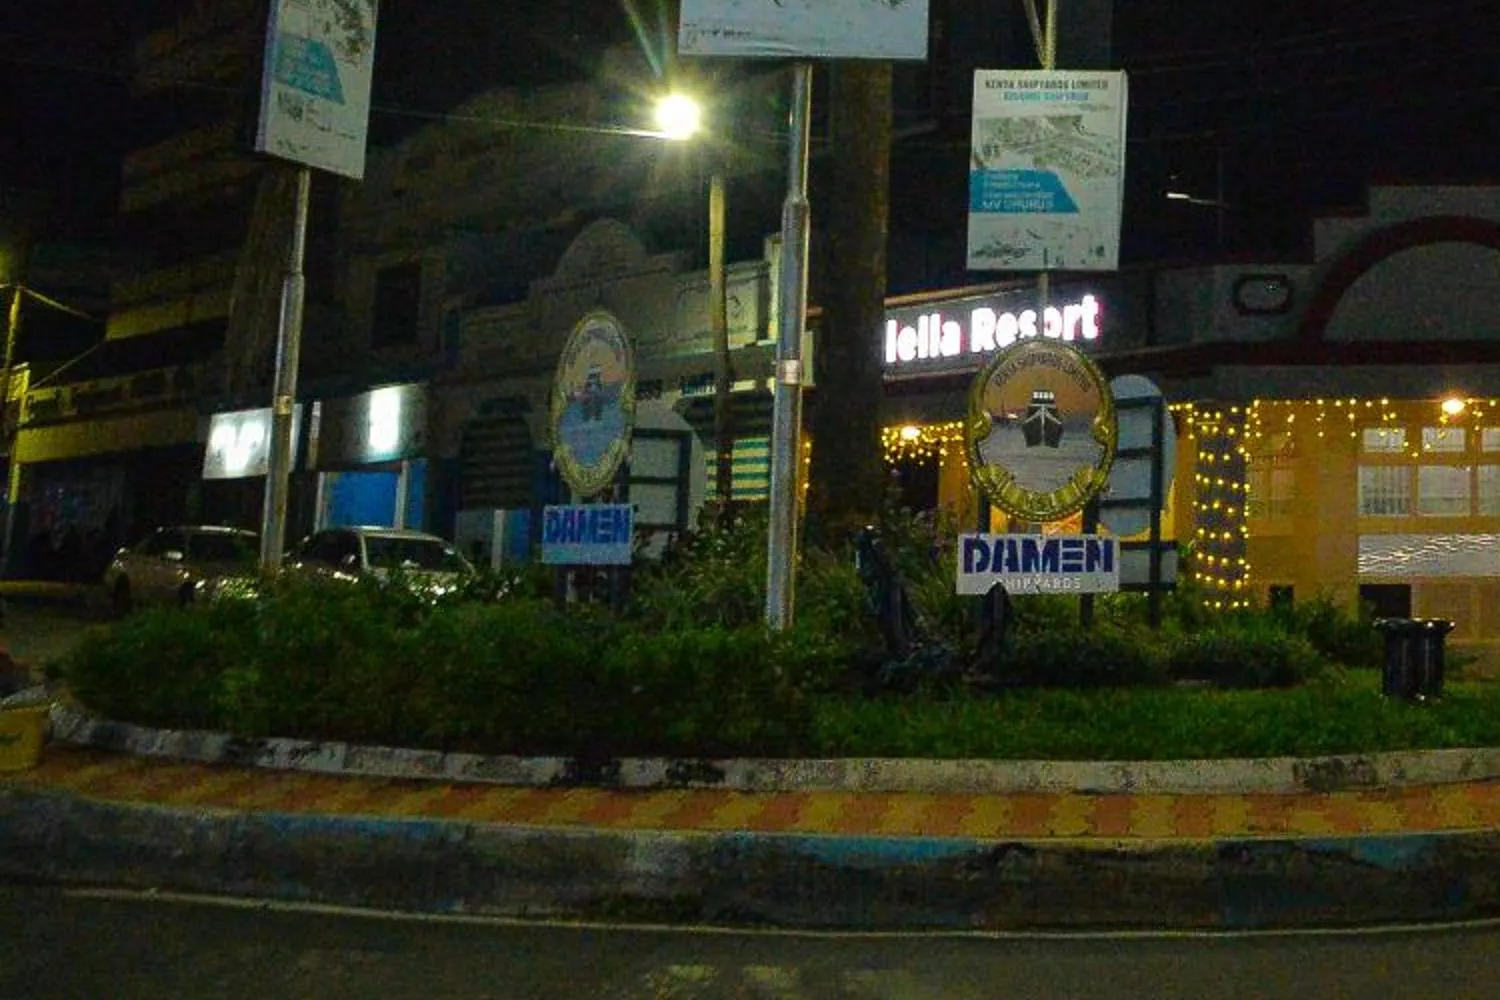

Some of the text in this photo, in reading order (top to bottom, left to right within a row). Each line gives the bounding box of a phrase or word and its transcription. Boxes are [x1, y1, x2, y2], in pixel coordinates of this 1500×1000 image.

[970, 294, 1100, 352] Resort
[546, 509, 630, 542] DAMEN
[963, 537, 1113, 574] DAMEN
